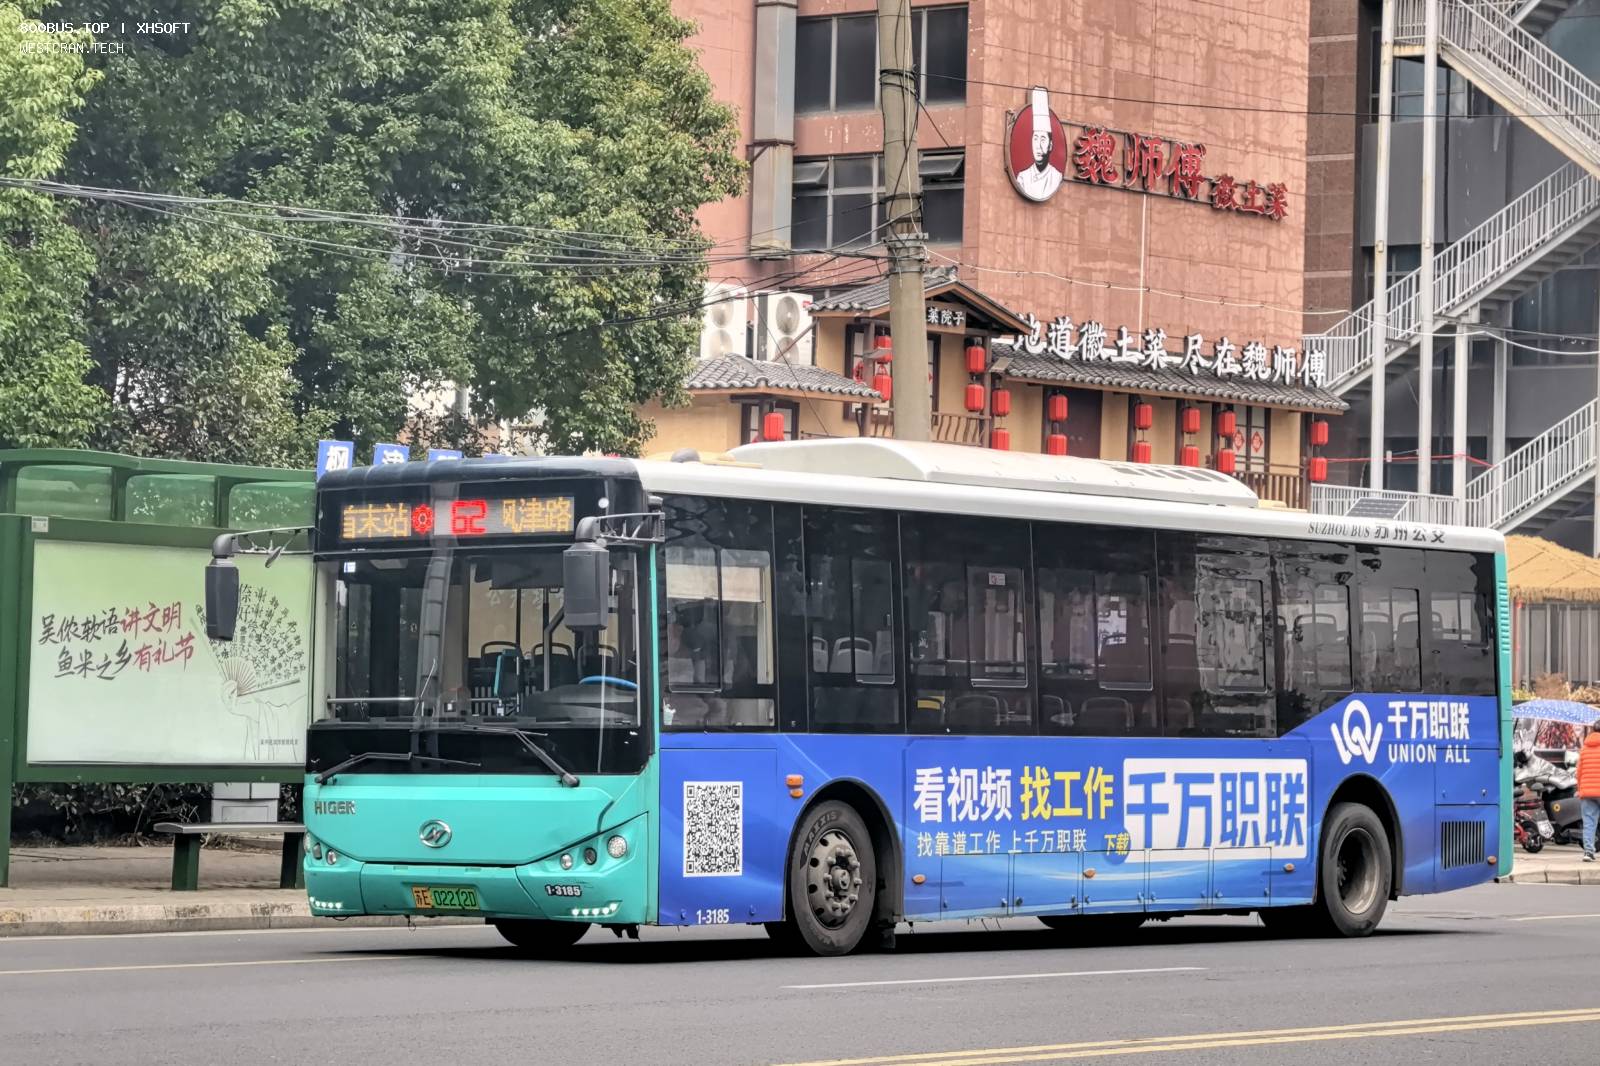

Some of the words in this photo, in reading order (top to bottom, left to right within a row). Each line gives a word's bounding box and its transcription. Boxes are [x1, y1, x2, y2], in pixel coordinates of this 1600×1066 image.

[1073, 127, 1206, 199] 魏师傅
[1179, 332, 1326, 388] 尽在魏师傅
[451, 499, 488, 534] 62
[1308, 521, 1348, 536] SUZHOU
[1351, 524, 1370, 538] BUS
[38, 601, 182, 645] 吴侬软语讲文明
[54, 631, 196, 681] 鱼米之乡有礼节
[1387, 701, 1470, 740] 千万职联
[1388, 743, 1437, 763] UNION
[1445, 744, 1471, 763] ALL
[314, 800, 356, 815] HIGER
[913, 766, 1013, 823] 看视频
[1020, 765, 1115, 821] 找工作
[1126, 771, 1305, 849] 千万职联
[917, 830, 1001, 857] 找靠谱工作
[1007, 828, 1088, 854] 上千万职联
[1104, 832, 1130, 856] 下载
[696, 908, 730, 924] 1-3185
